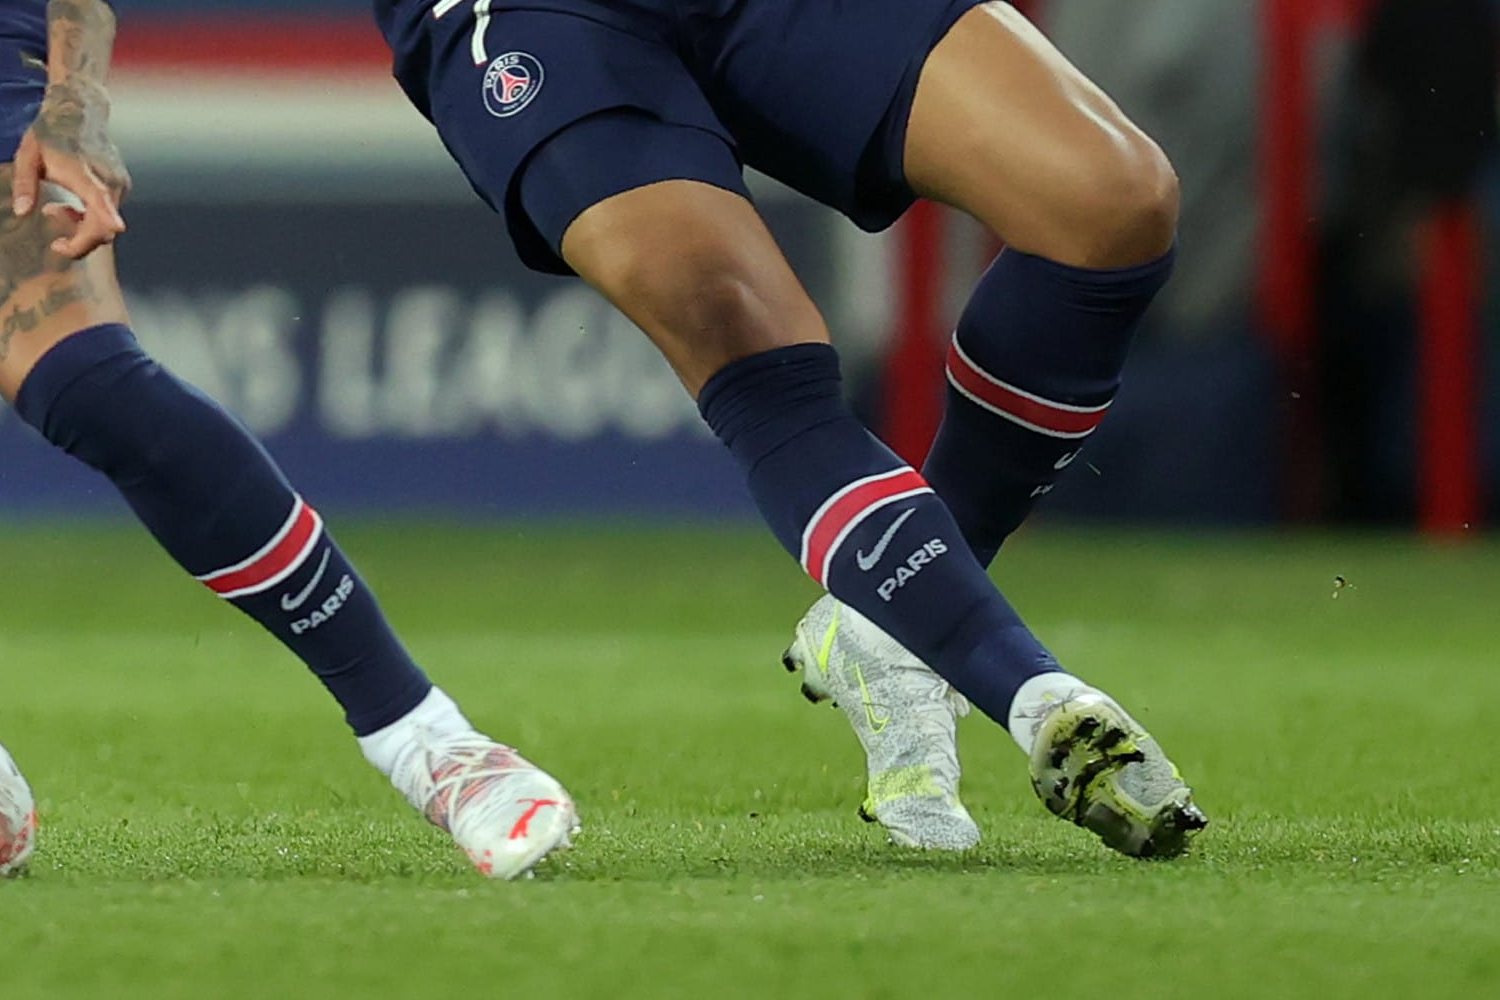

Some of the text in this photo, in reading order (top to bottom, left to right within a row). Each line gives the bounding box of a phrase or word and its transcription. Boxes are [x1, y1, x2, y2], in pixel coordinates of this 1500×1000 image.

[484, 55, 520, 89] PARIS
[876, 538, 948, 602] PARIS
[290, 574, 355, 635] PARIS
